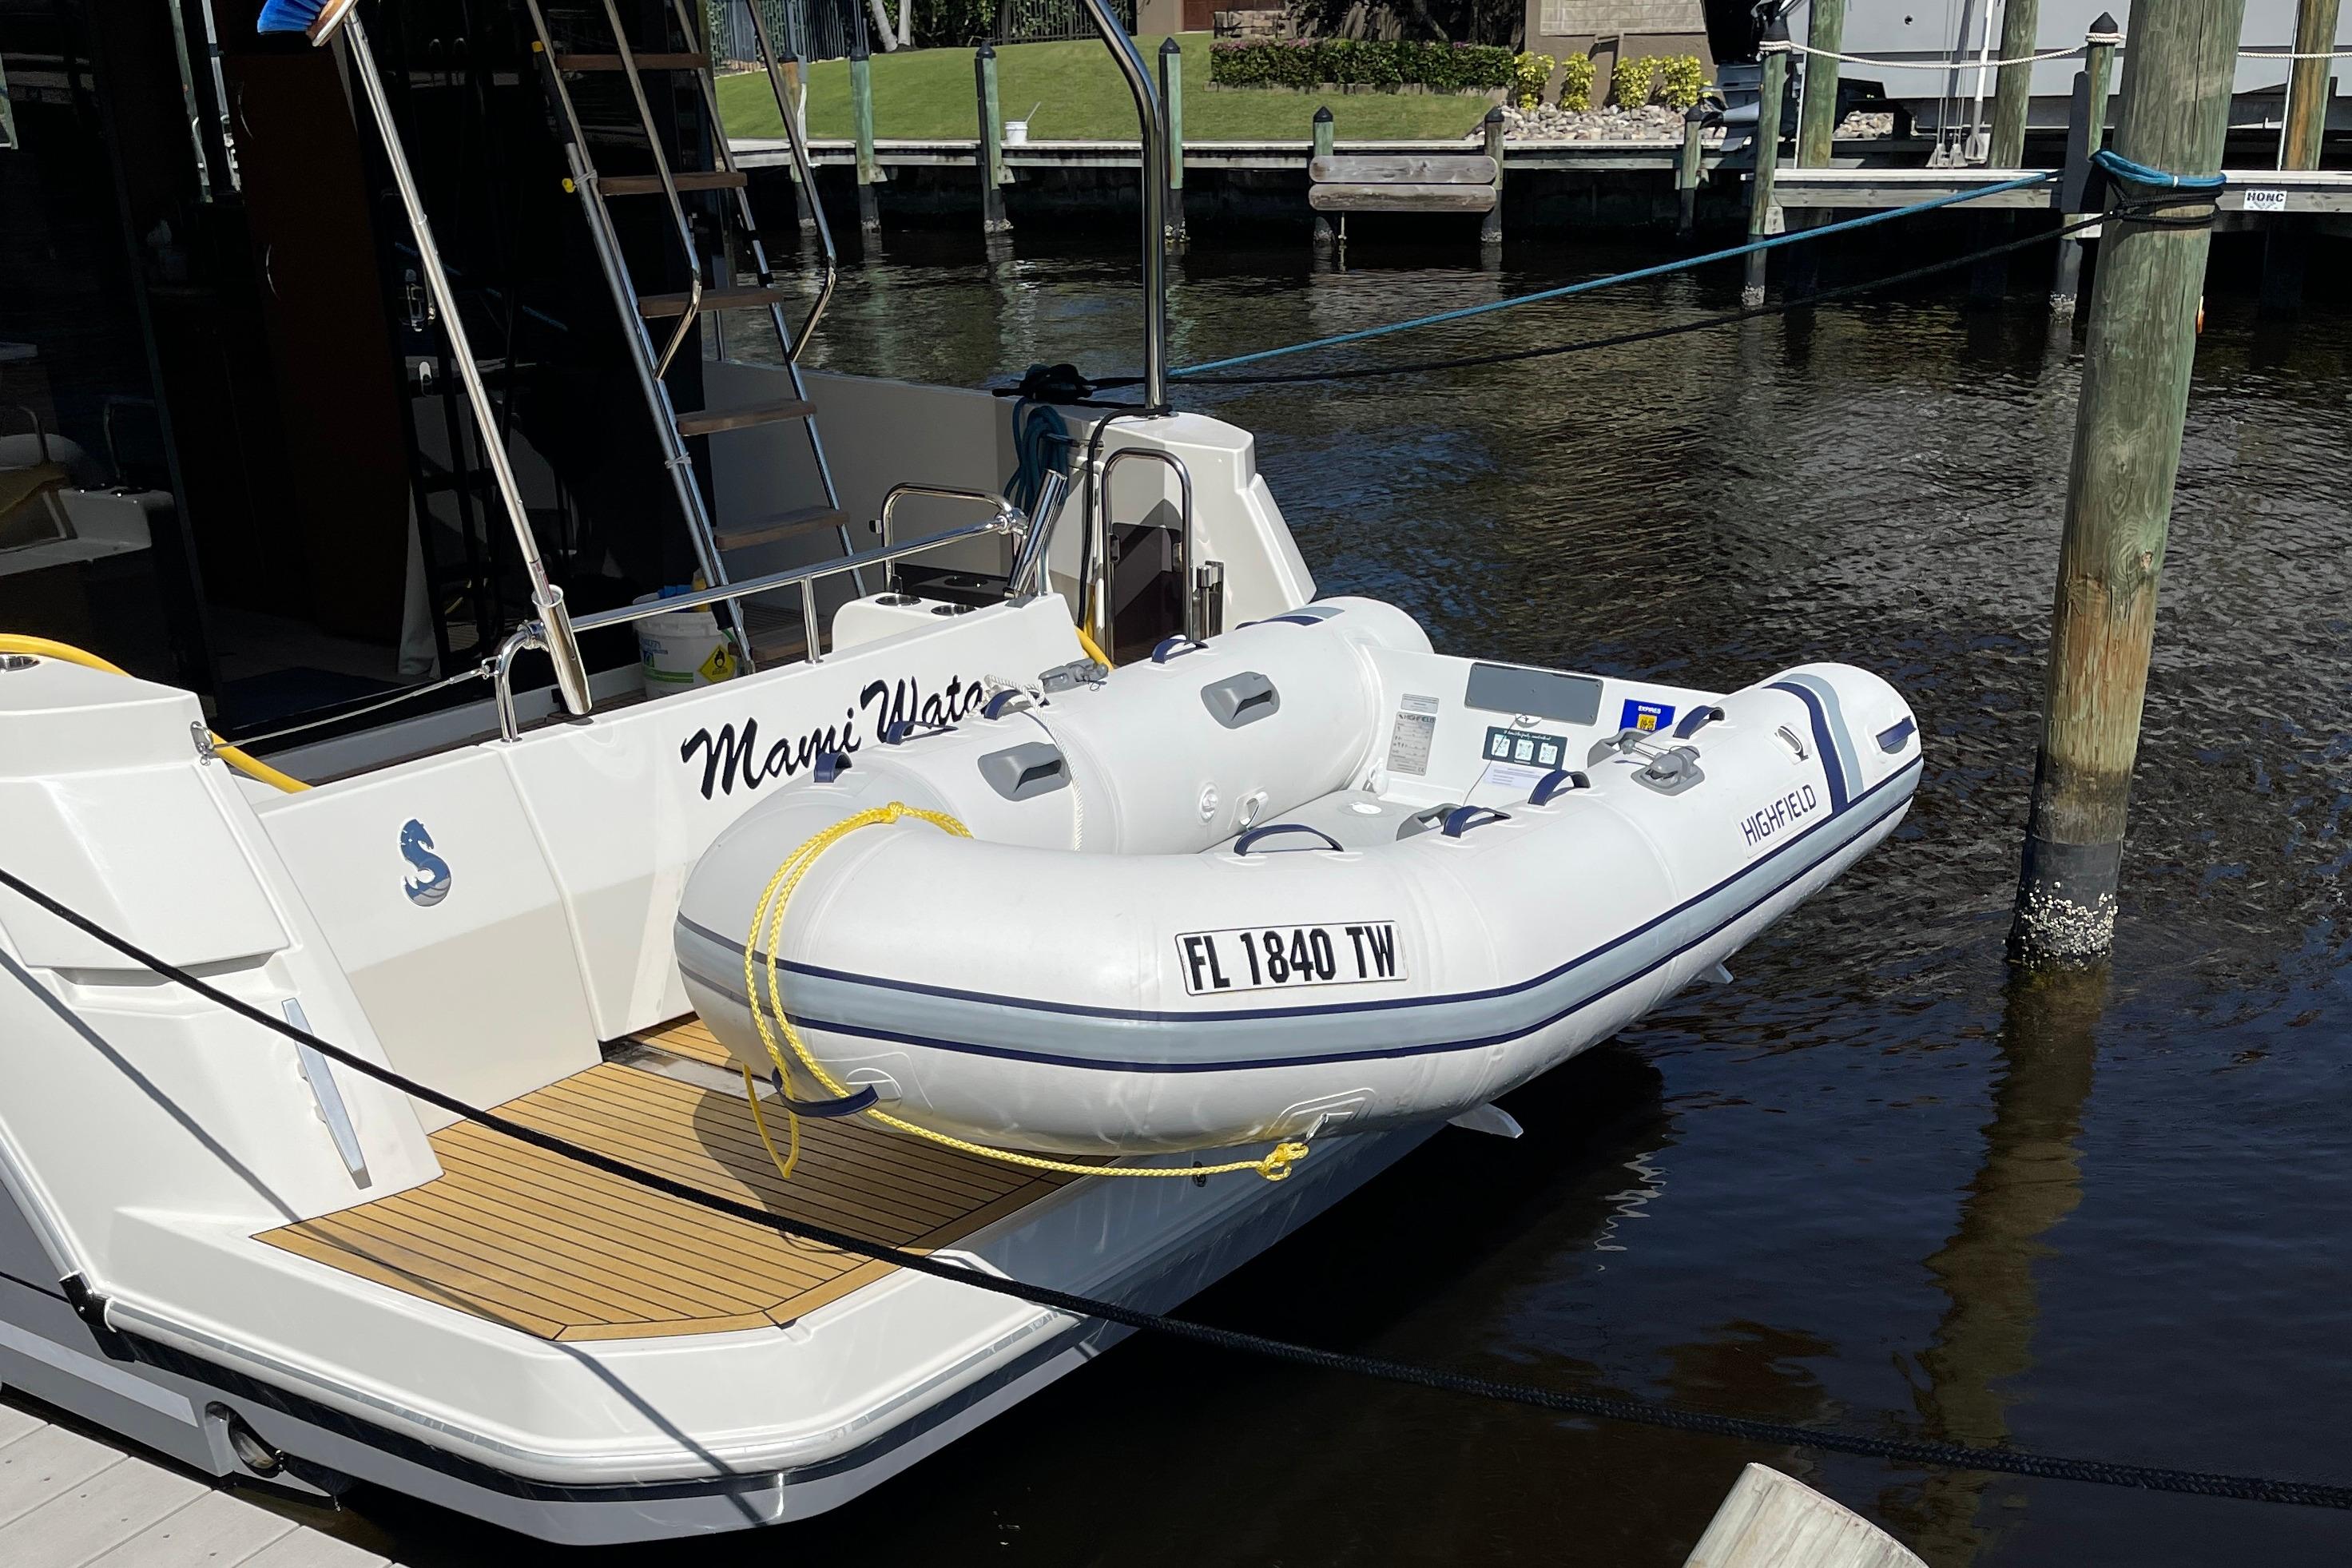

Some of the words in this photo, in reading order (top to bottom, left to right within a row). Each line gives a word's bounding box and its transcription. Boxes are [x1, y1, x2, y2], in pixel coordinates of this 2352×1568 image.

[2247, 192, 2285, 202] HONC
[681, 708, 861, 800] Mami
[1740, 784, 1817, 847] HIGHFIELD
[1183, 935, 1231, 990] FL
[1239, 927, 1337, 986] 1840
[1345, 924, 1395, 979] TW
